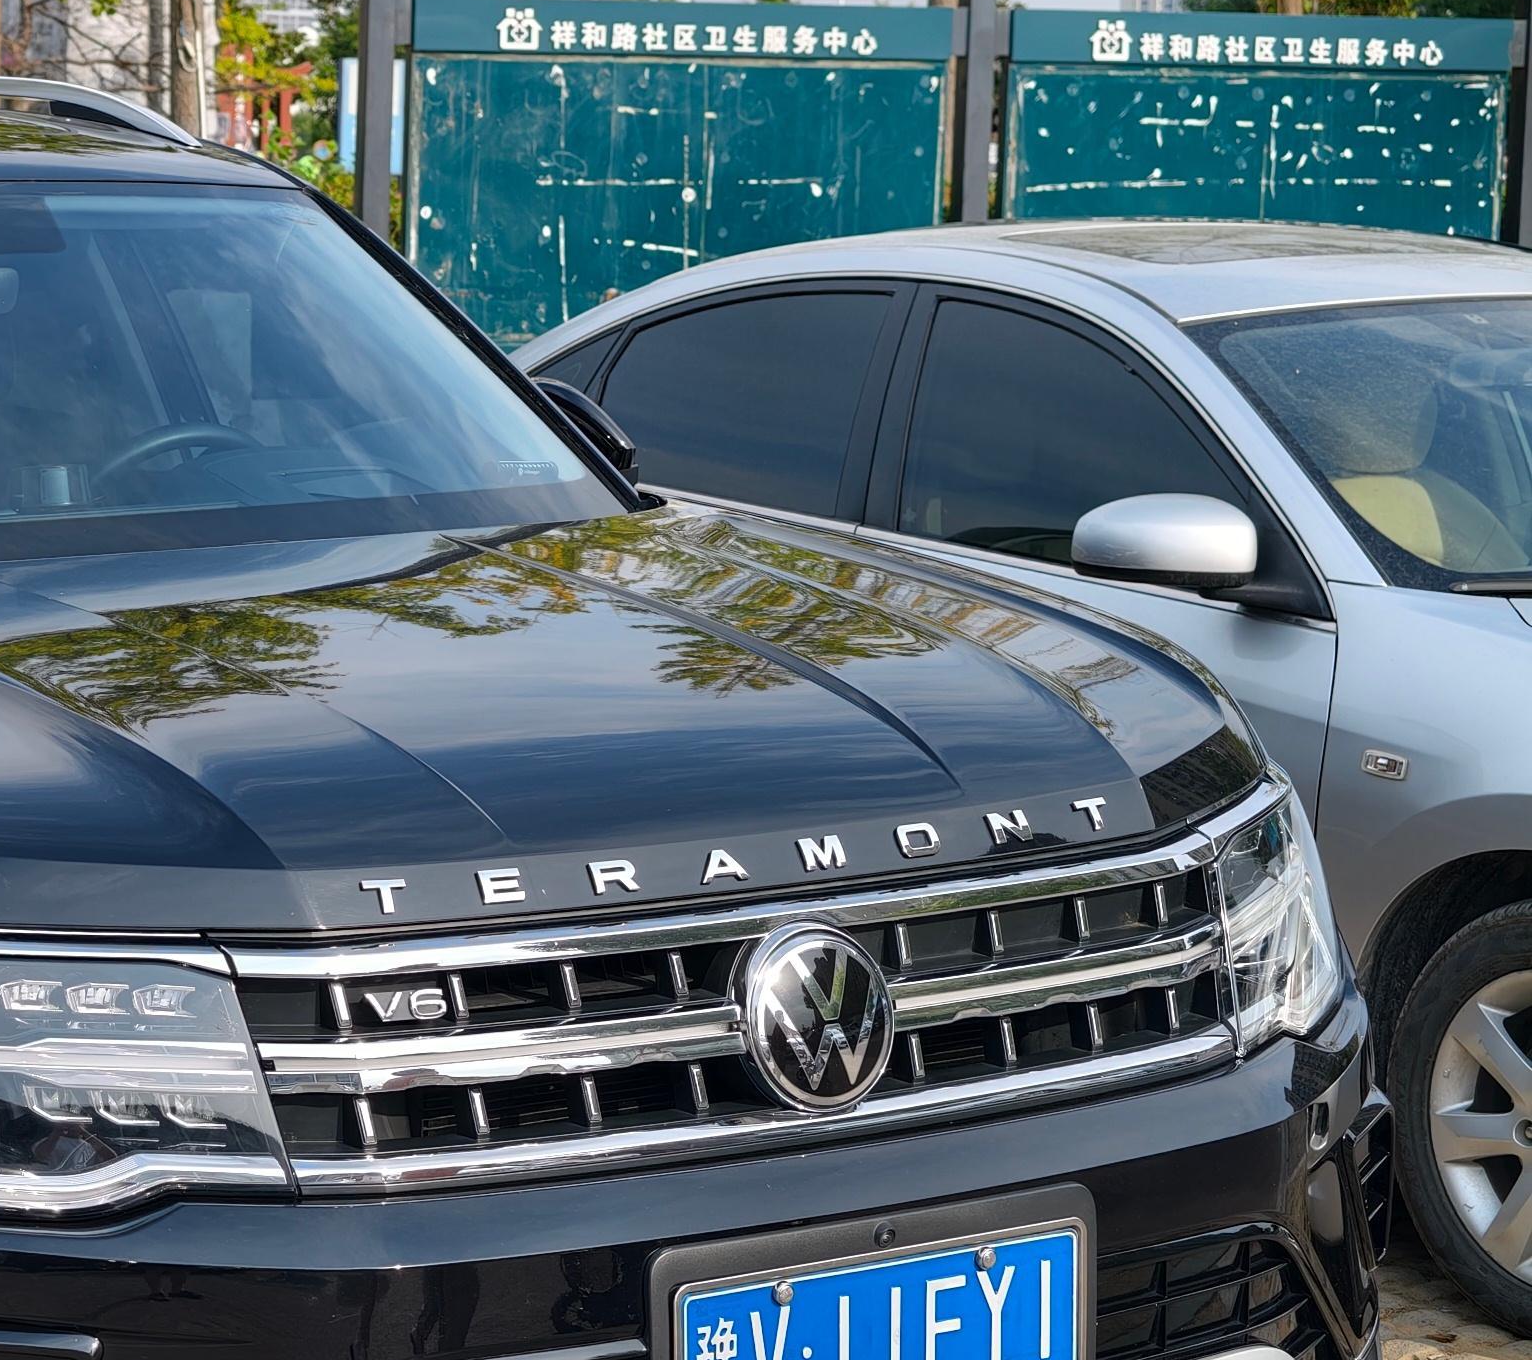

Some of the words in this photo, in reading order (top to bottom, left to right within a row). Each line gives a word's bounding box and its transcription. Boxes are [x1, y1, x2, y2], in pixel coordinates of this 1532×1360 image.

[550, 20, 878, 56] 祥和路社区卫生服务中心
[1139, 32, 1444, 67] 祥和路社区卫生服务中心
[359, 796, 1107, 915] TERAMONT
[363, 988, 448, 1024] V6
